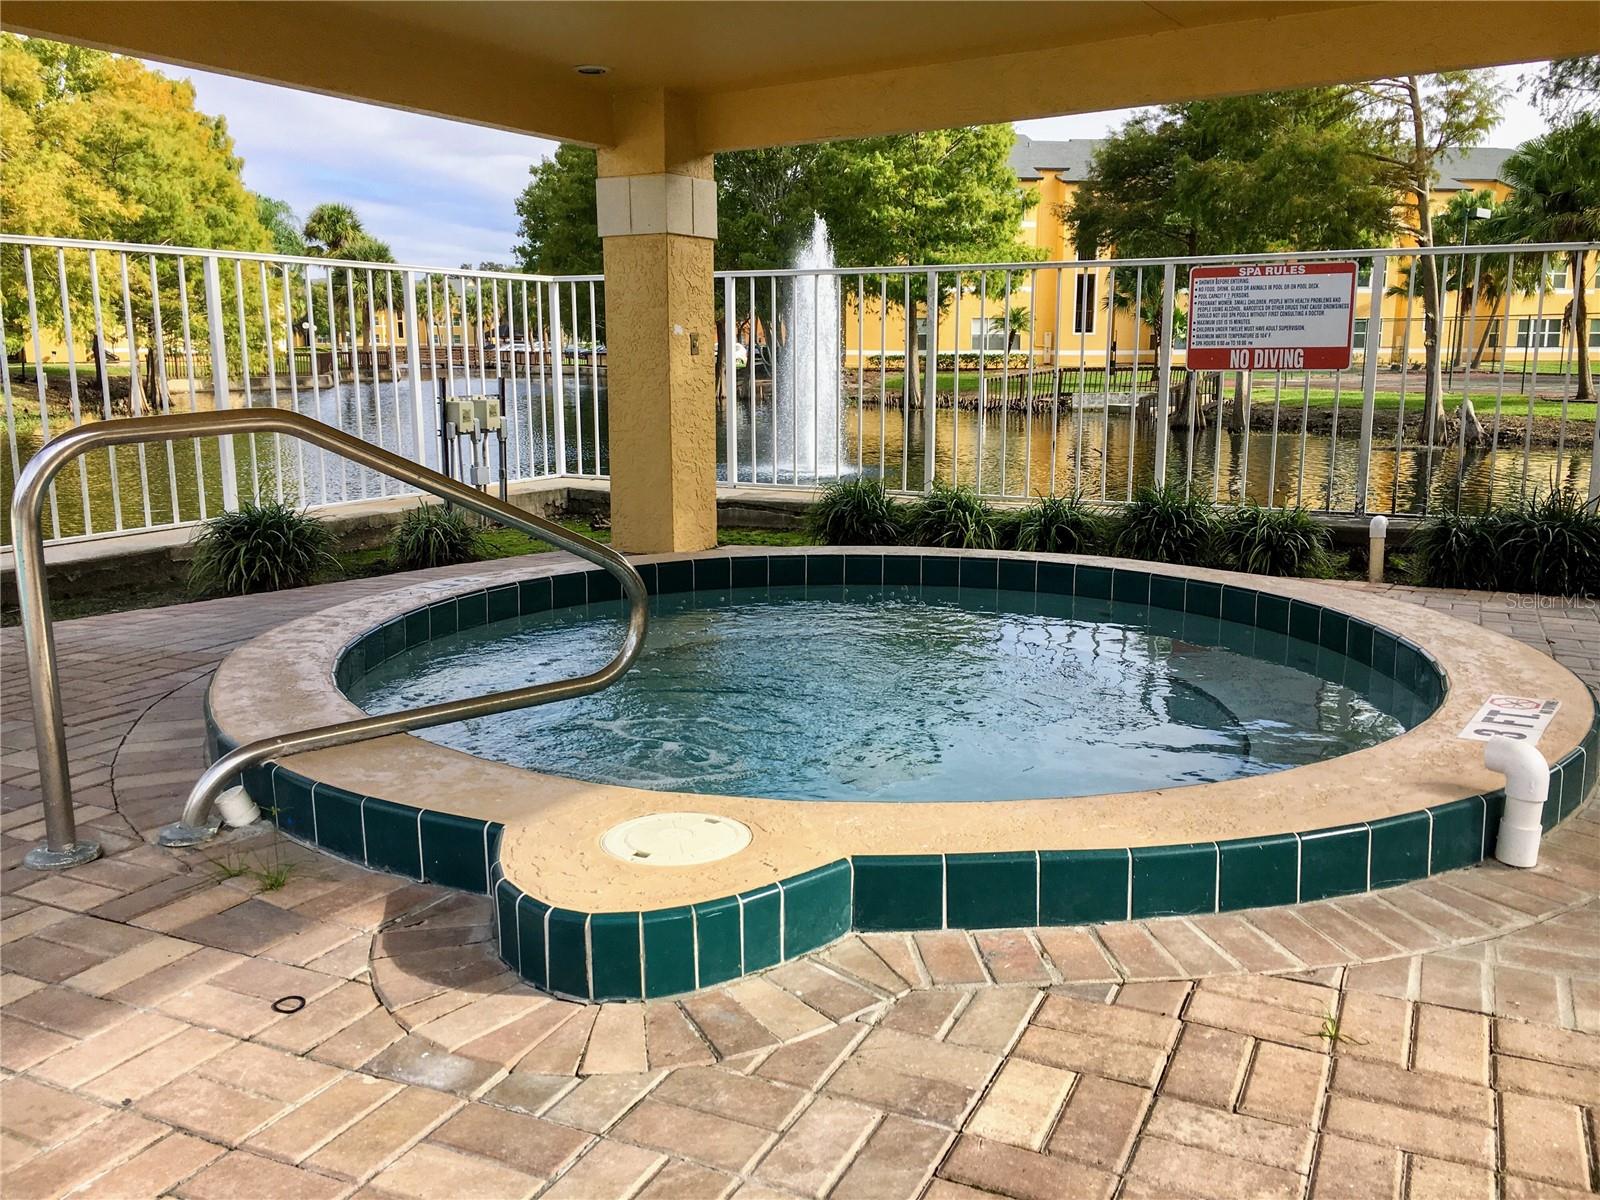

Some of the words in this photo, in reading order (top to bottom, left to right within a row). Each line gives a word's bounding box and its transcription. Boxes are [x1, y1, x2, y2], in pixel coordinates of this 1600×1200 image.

[1238, 267, 1262, 276] SPA
[1265, 265, 1306, 275] RULES
[1230, 349, 1250, 368] NO
[1254, 348, 1304, 368] DIVING
[1474, 728, 1527, 740] 3
